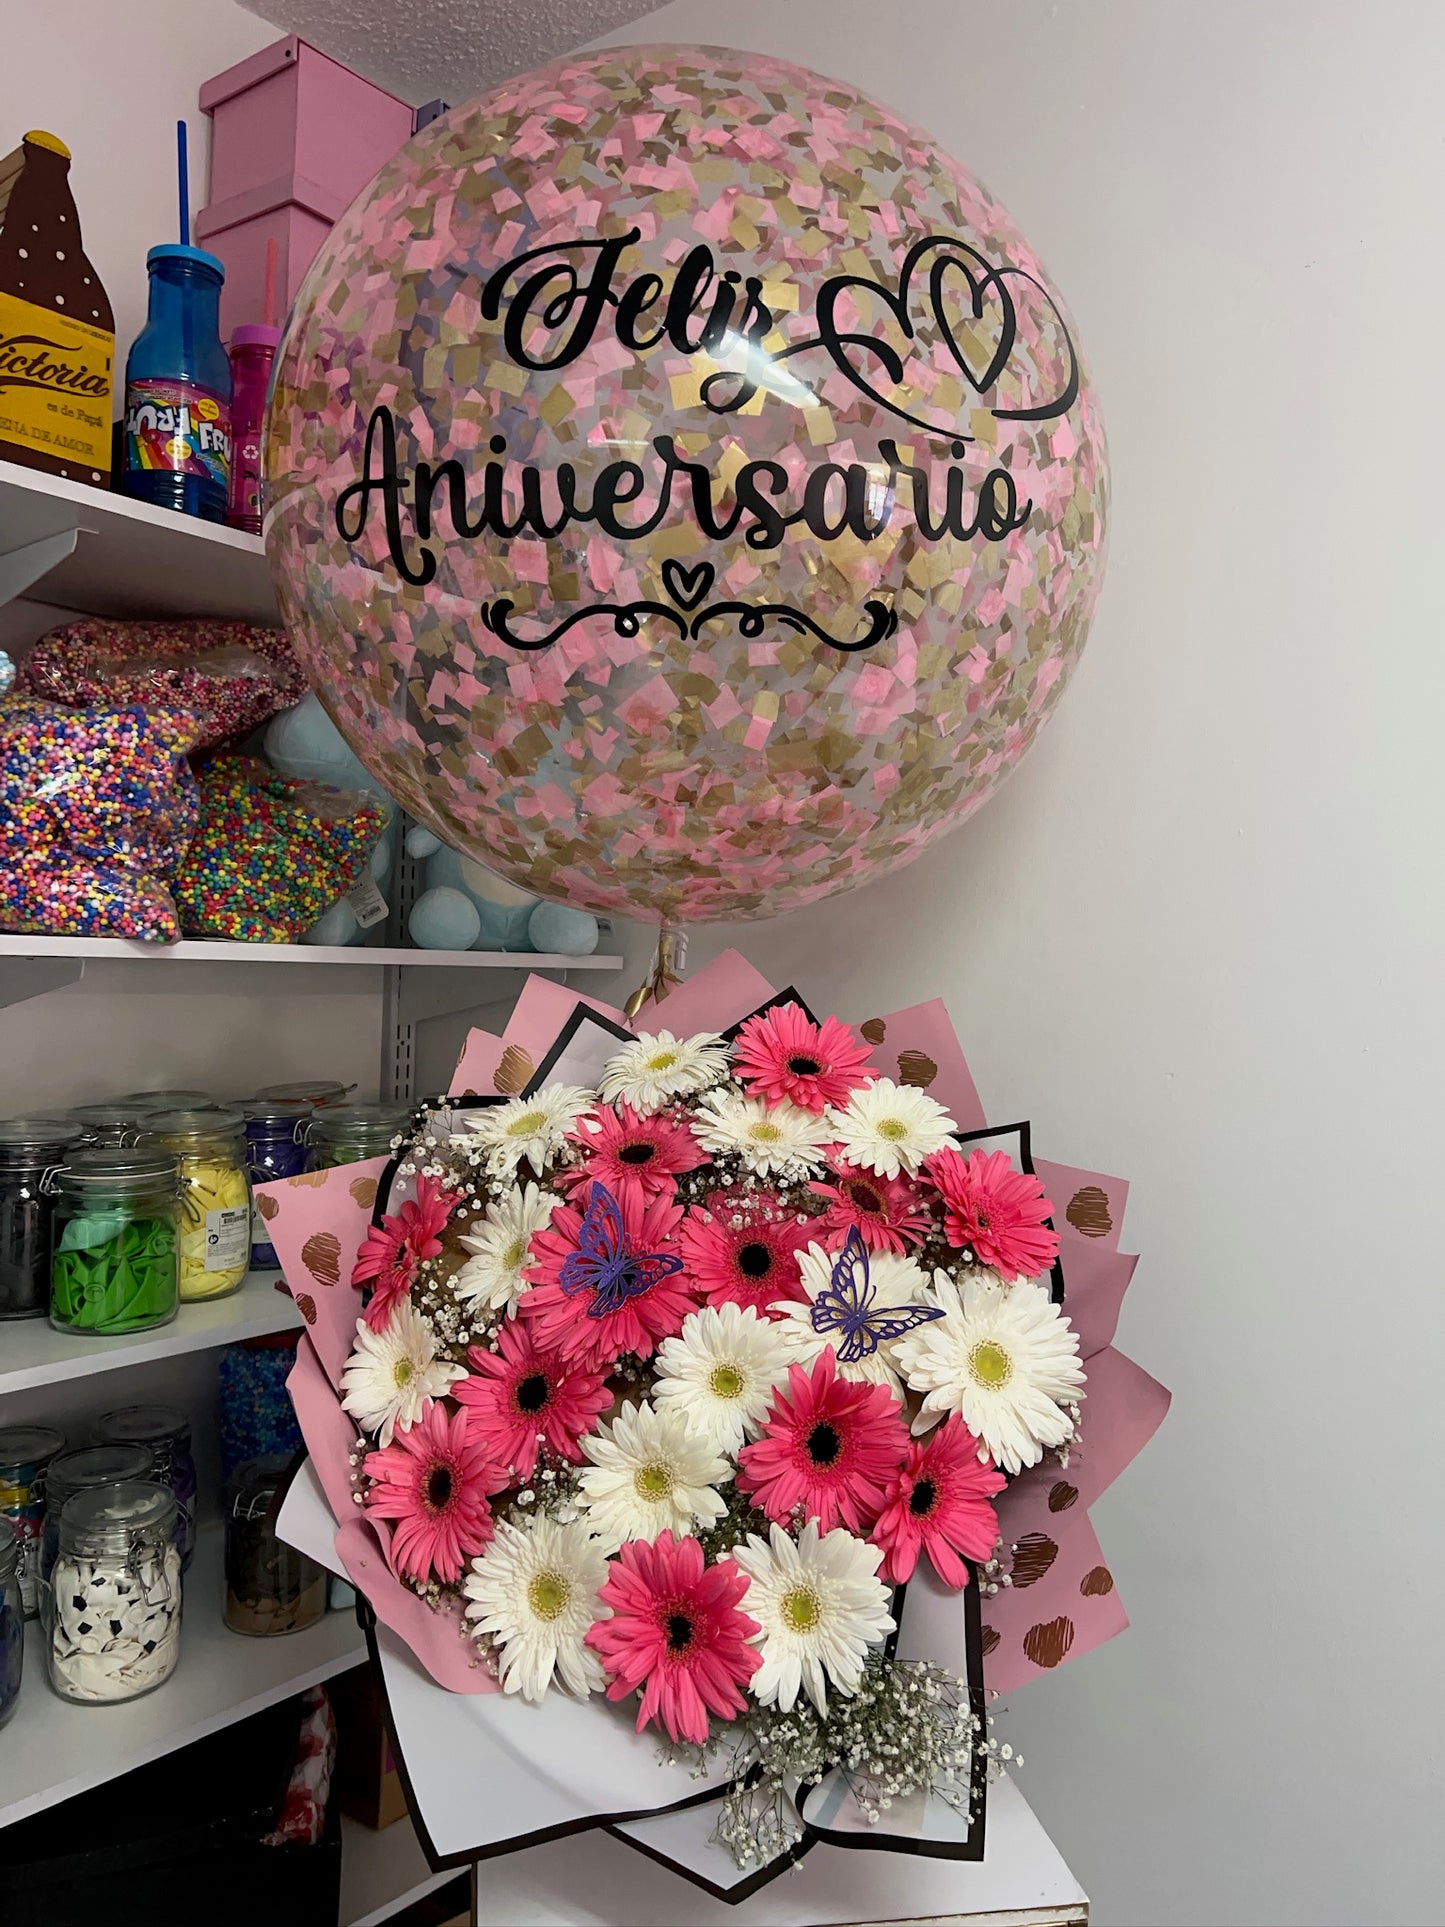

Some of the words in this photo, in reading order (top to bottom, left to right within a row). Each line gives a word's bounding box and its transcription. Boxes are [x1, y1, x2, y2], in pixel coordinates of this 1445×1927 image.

[481, 227, 773, 414] Feliz
[0, 346, 109, 395] ictoria
[61, 404, 74, 418] de
[31, 427, 51, 443] DE
[53, 434, 95, 456] AMOR
[336, 406, 1032, 587] Aniversario
